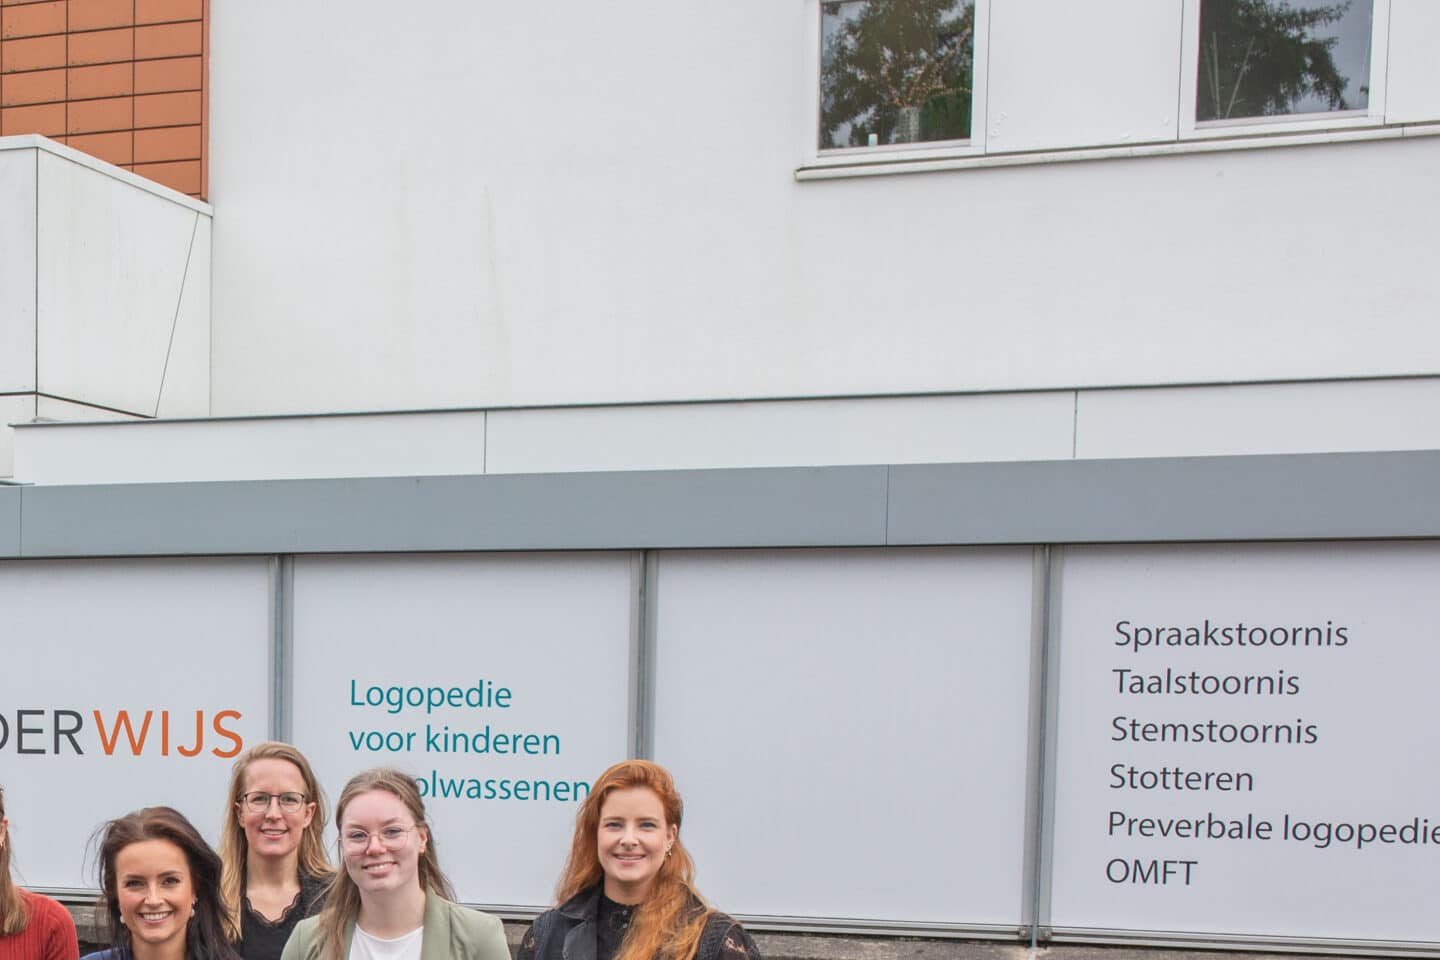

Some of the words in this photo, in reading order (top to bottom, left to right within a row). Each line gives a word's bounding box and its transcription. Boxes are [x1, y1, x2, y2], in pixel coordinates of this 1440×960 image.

[1114, 620, 1348, 652] Spraakstoornis
[1112, 668, 1300, 695] Taalstoornis
[350, 680, 512, 714] Logopedie
[349, 732, 416, 752] voor
[426, 724, 561, 754] kinderen
[1111, 717, 1318, 744] Stemstoornis
[416, 770, 590, 801] olwassenen
[1109, 764, 1253, 791] Stotteren
[1108, 811, 1273, 840] Preverbale
[1283, 814, 1440, 849] logopedie
[1106, 859, 1199, 885] OMFT
